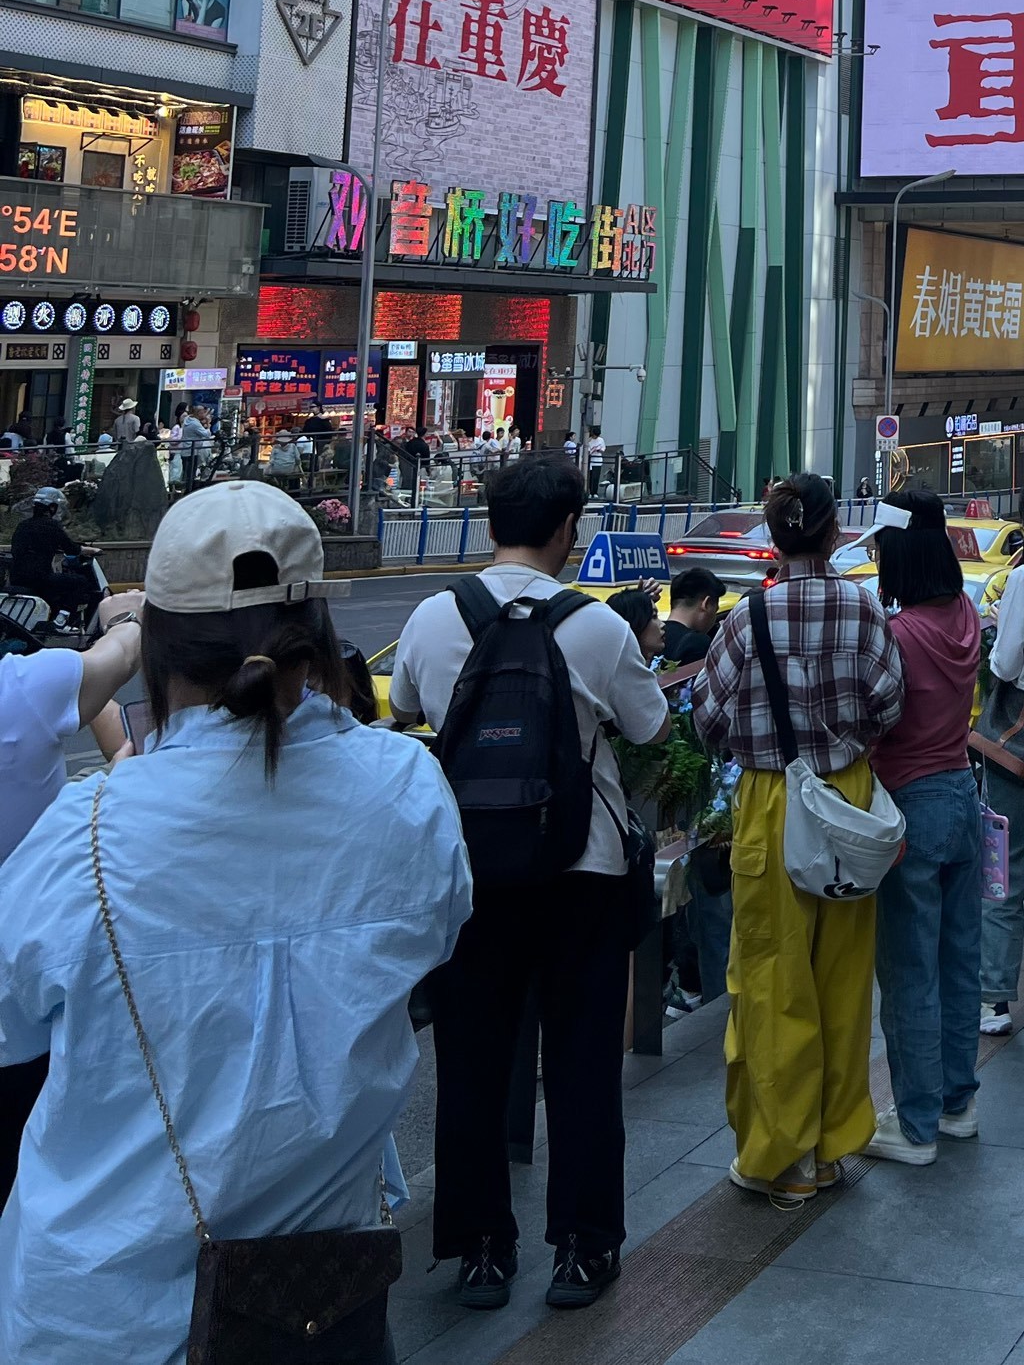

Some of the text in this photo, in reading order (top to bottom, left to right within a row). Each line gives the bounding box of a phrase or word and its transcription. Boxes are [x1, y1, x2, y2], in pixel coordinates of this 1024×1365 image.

[325, 170, 624, 272] 观音桥好吃街
[626, 204, 657, 237] A区
[624, 240, 656, 272] 北门
[910, 264, 1023, 341] 春娟黄芪霜
[440, 352, 486, 373] 蜜雪冰城
[616, 544, 666, 571] 江小白
